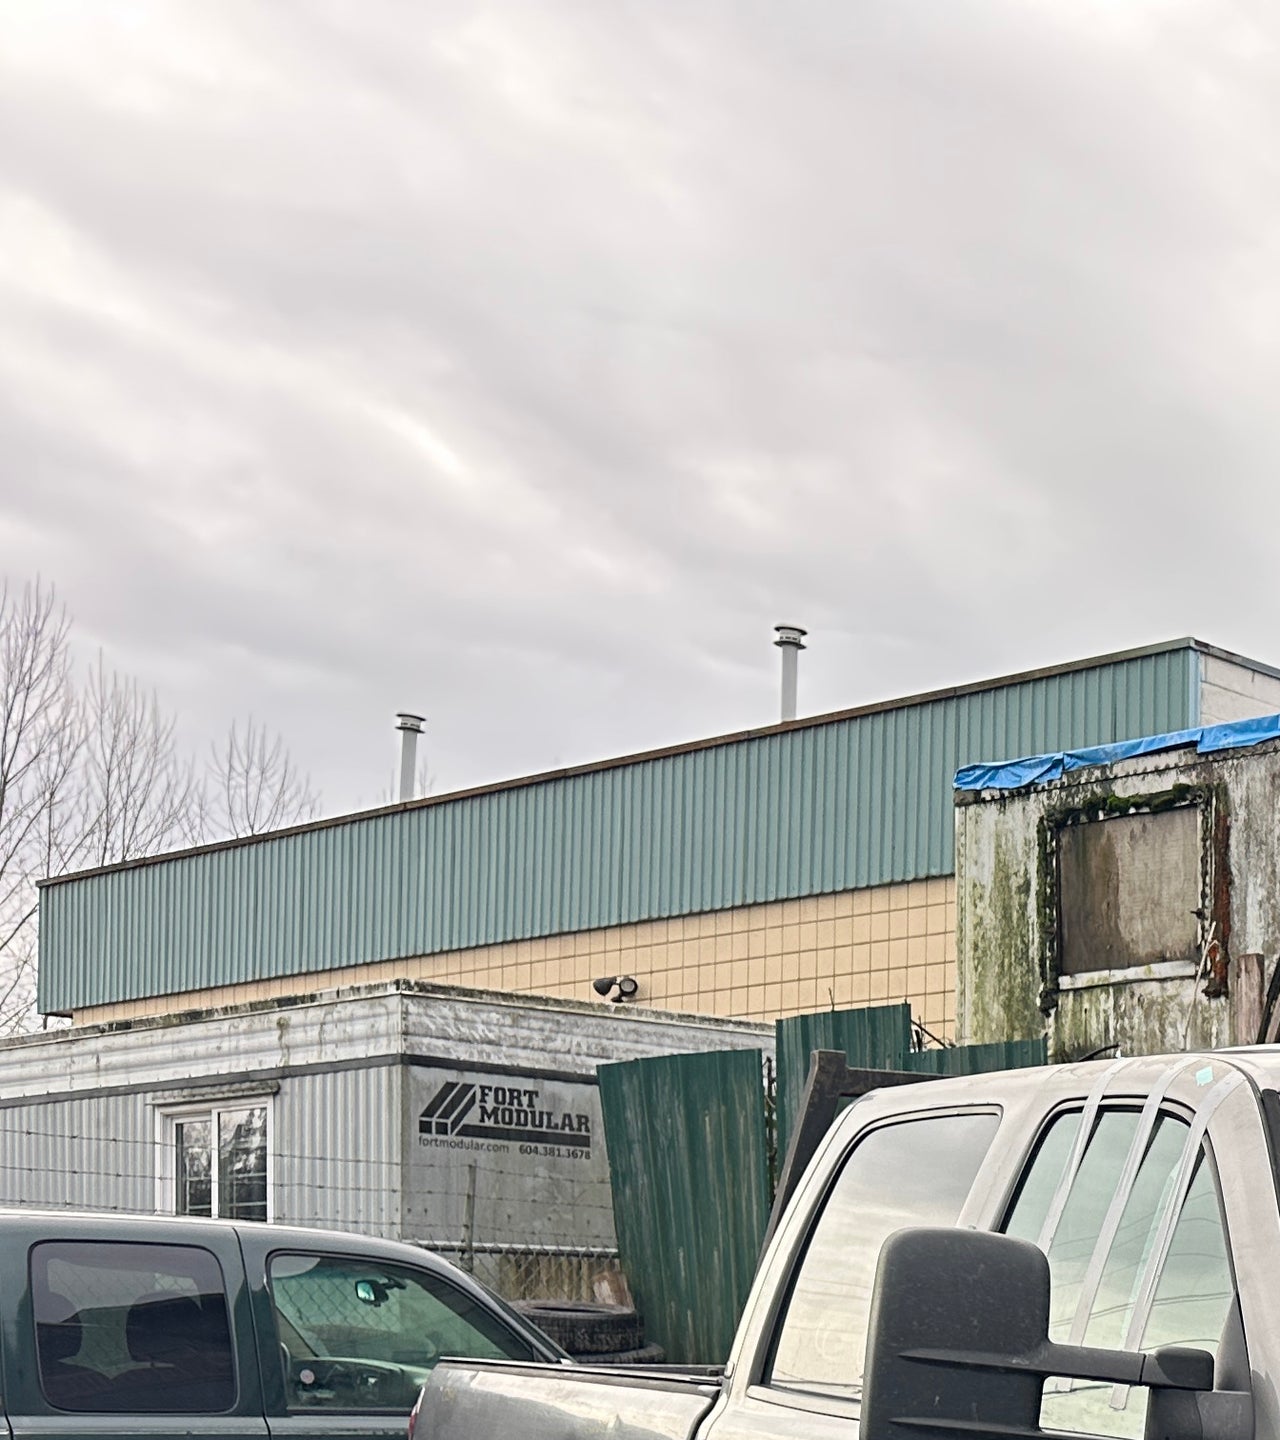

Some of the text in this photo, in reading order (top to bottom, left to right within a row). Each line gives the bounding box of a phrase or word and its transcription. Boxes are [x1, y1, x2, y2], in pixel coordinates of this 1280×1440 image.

[478, 1085, 539, 1109] FORT
[478, 1105, 591, 1133] MODULAR
[418, 1135, 510, 1154] fortmodular.com
